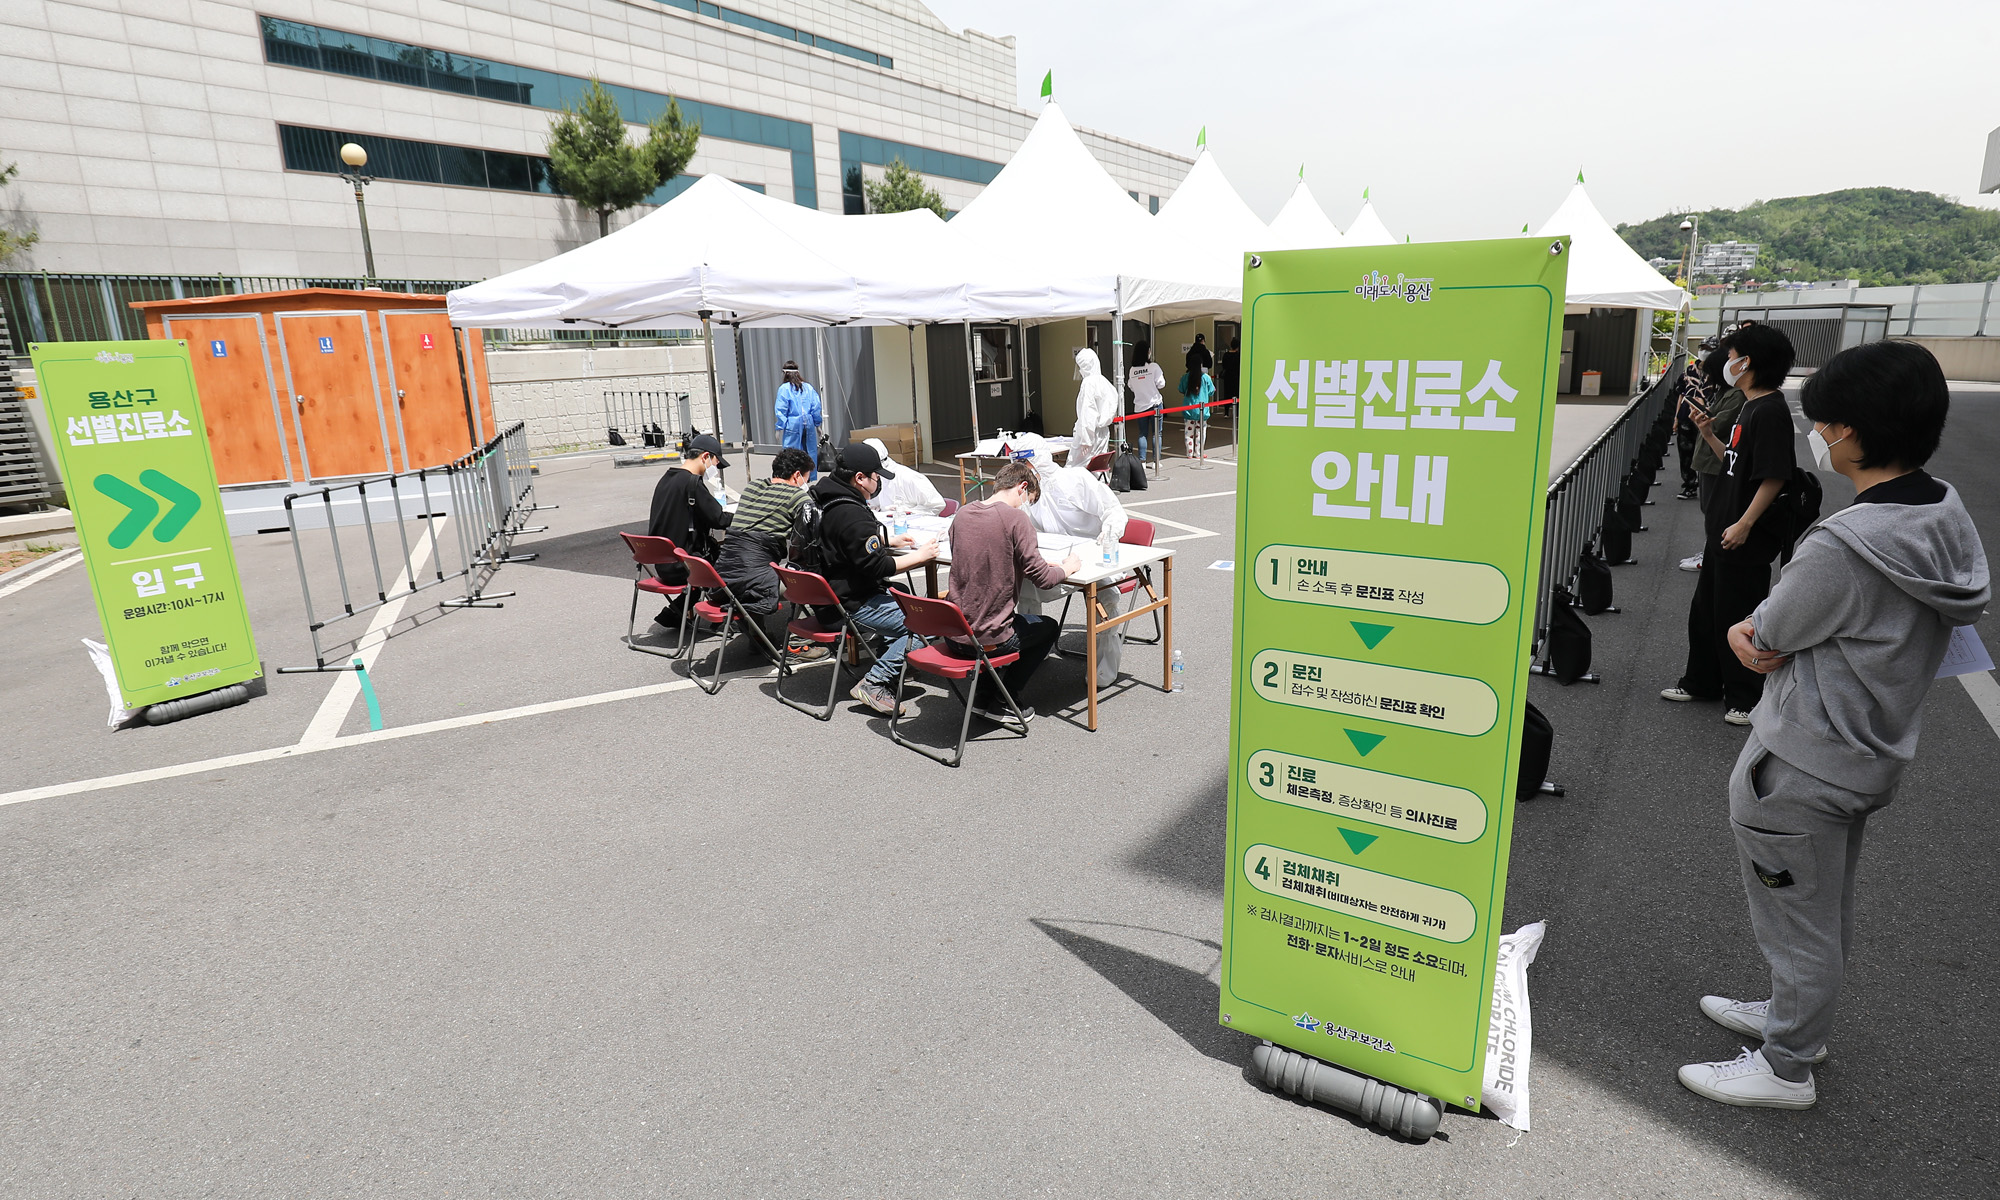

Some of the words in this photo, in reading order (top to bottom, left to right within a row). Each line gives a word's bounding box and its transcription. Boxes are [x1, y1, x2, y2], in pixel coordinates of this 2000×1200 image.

[1355, 282, 1401, 301] 미래도시
[1404, 283, 1432, 303] 용산
[88, 389, 158, 409] 용산구
[1265, 359, 1519, 432] 선별진료소
[66, 409, 193, 446] 선별진료소
[1310, 451, 1449, 526] 안내
[1270, 558, 1279, 585] 1
[1297, 558, 1328, 576] 안내
[123, 591, 225, 620] 운영시간:10시~17시
[1297, 579, 1309, 592] 손
[1312, 580, 1337, 595] 소독
[1340, 583, 1353, 596] 후
[1356, 585, 1394, 601] 문진표
[1398, 589, 1424, 605] 작성
[145, 655, 174, 668] 이겨낼
[177, 653, 186, 661] 수
[188, 642, 227, 658] 있습니다!
[160, 643, 180, 655] 함께
[181, 637, 209, 649] 막으면
[1263, 661, 1279, 688] 2
[1292, 663, 1322, 682] 문진
[1291, 682, 1314, 697] 접수
[1316, 686, 1328, 700] 및
[1330, 689, 1378, 708] 작성하신
[1379, 697, 1417, 715] 문진표
[1419, 703, 1445, 720] 확인
[1259, 762, 1274, 787] 3
[1287, 765, 1316, 784] 진료
[1286, 783, 1335, 805] 체온측정,
[1338, 794, 1387, 816] 증상확인
[1390, 805, 1402, 819] 등
[1405, 809, 1457, 831] 의사진료
[1254, 856, 1271, 881] 4
[1283, 860, 1340, 887] 검체채취
[1380, 904, 1419, 923] 안전하게
[1422, 915, 1446, 930] 귀가)
[1260, 907, 1340, 941] 검사결과까지는
[1343, 931, 1381, 953] 1~2일
[1384, 942, 1410, 960] 정도
[1412, 951, 1468, 978] 소요되며,
[1390, 964, 1416, 983] 안내
[1487, 984, 1502, 1056] YDRATE
[1323, 1021, 1396, 1053] 용산구보건소
[1494, 1007, 1517, 1094] CHLORIDE
